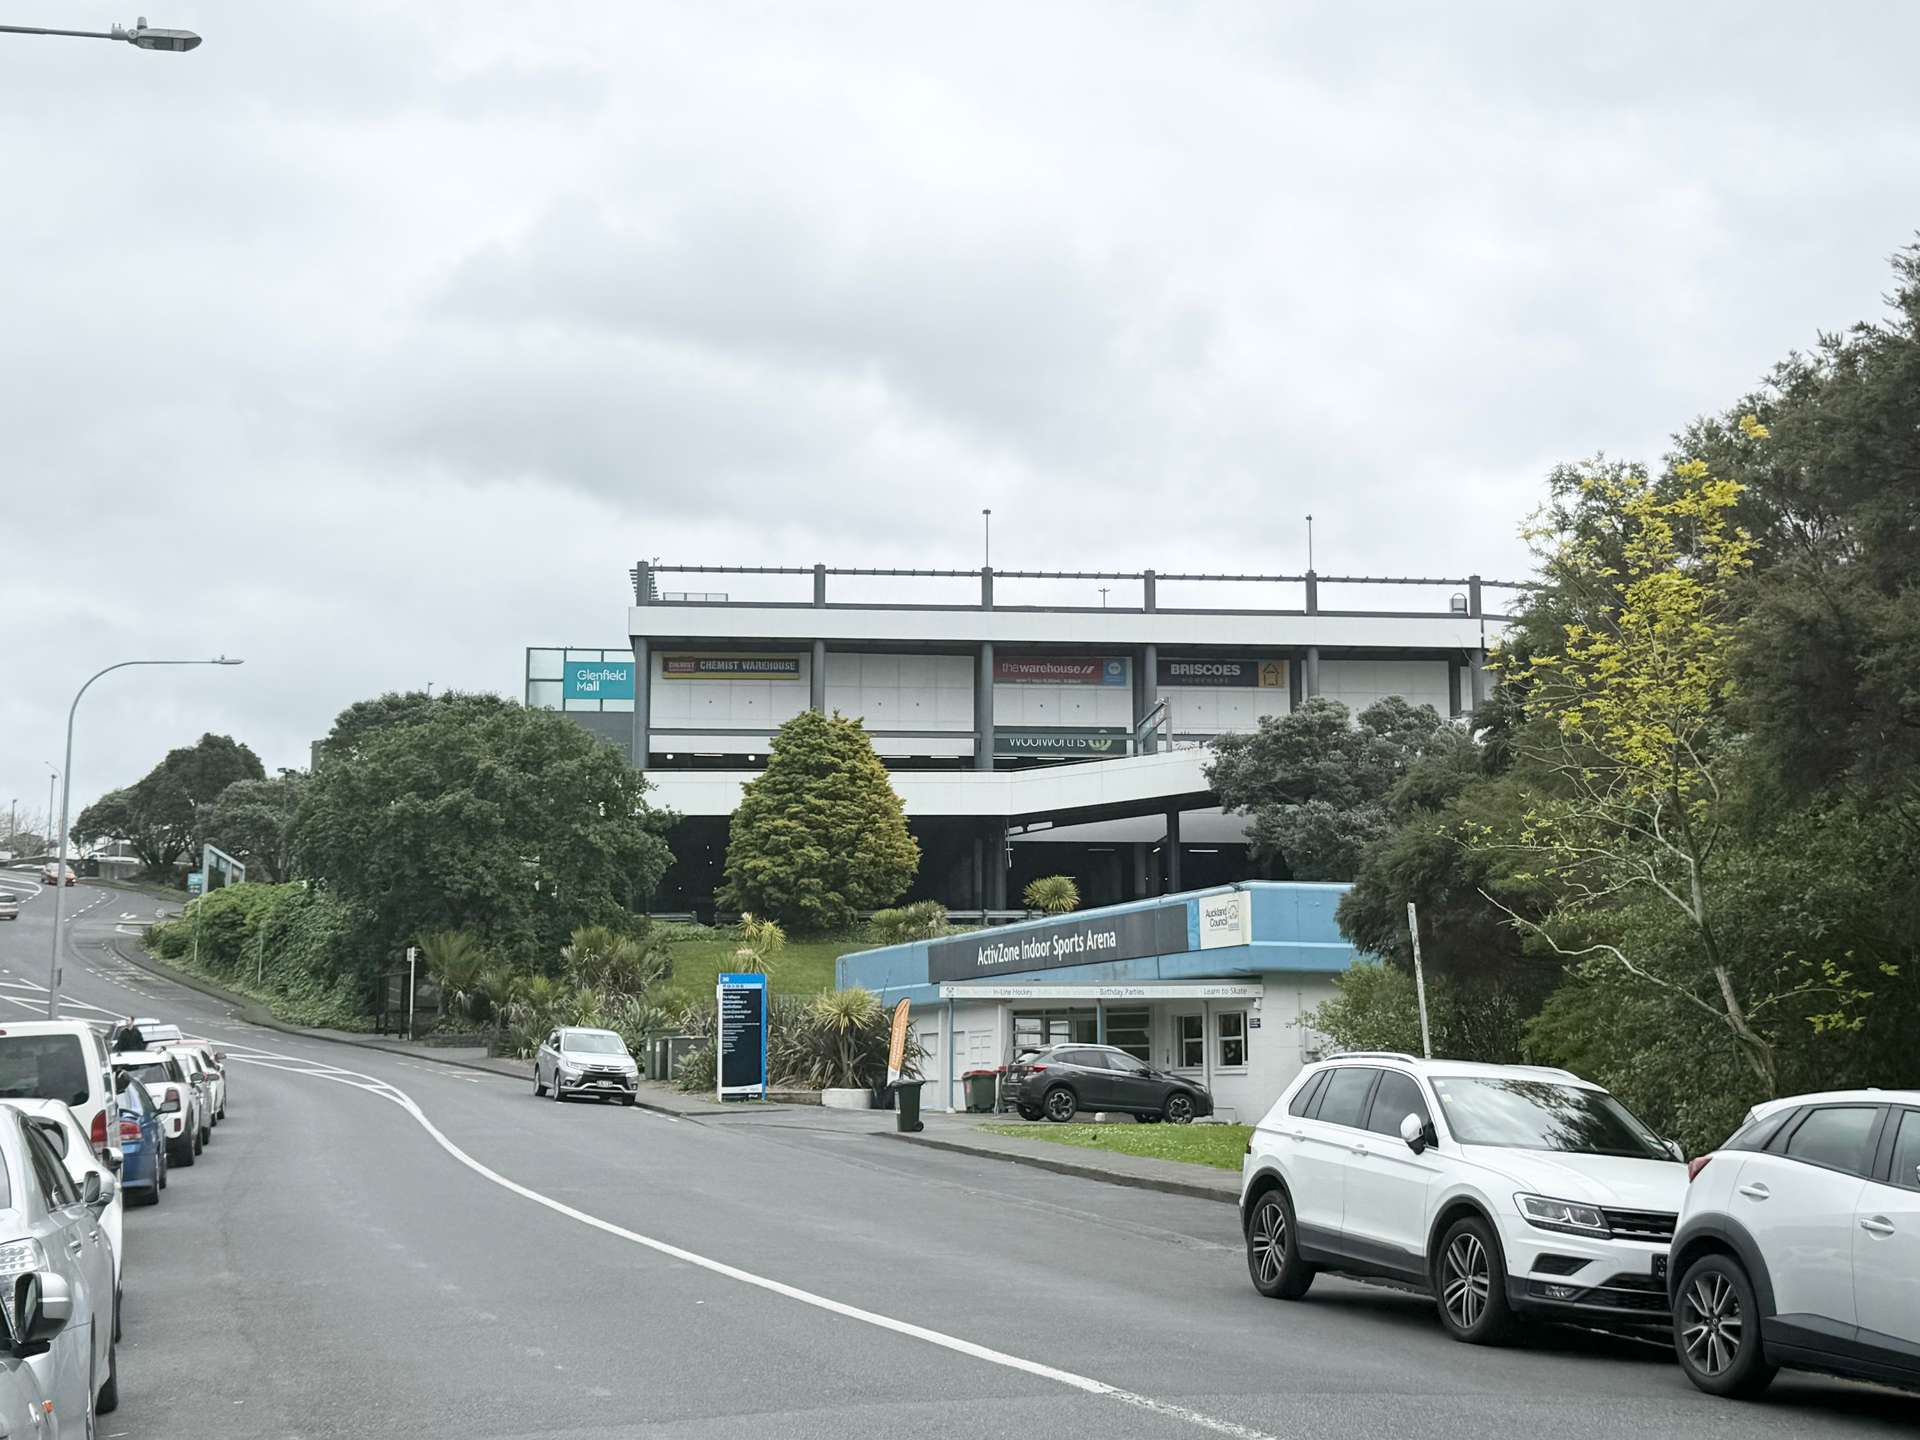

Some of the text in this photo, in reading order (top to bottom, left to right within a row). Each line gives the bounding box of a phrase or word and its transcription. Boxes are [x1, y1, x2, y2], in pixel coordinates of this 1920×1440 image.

[700, 661, 795, 671] CHEMIST WAREHOUSE
[1170, 664, 1241, 676] BRISCOES
[576, 669, 627, 681] Glenfield
[576, 680, 600, 691] Mall
[977, 929, 1116, 965] ActivZone Indoor Sports Arena
